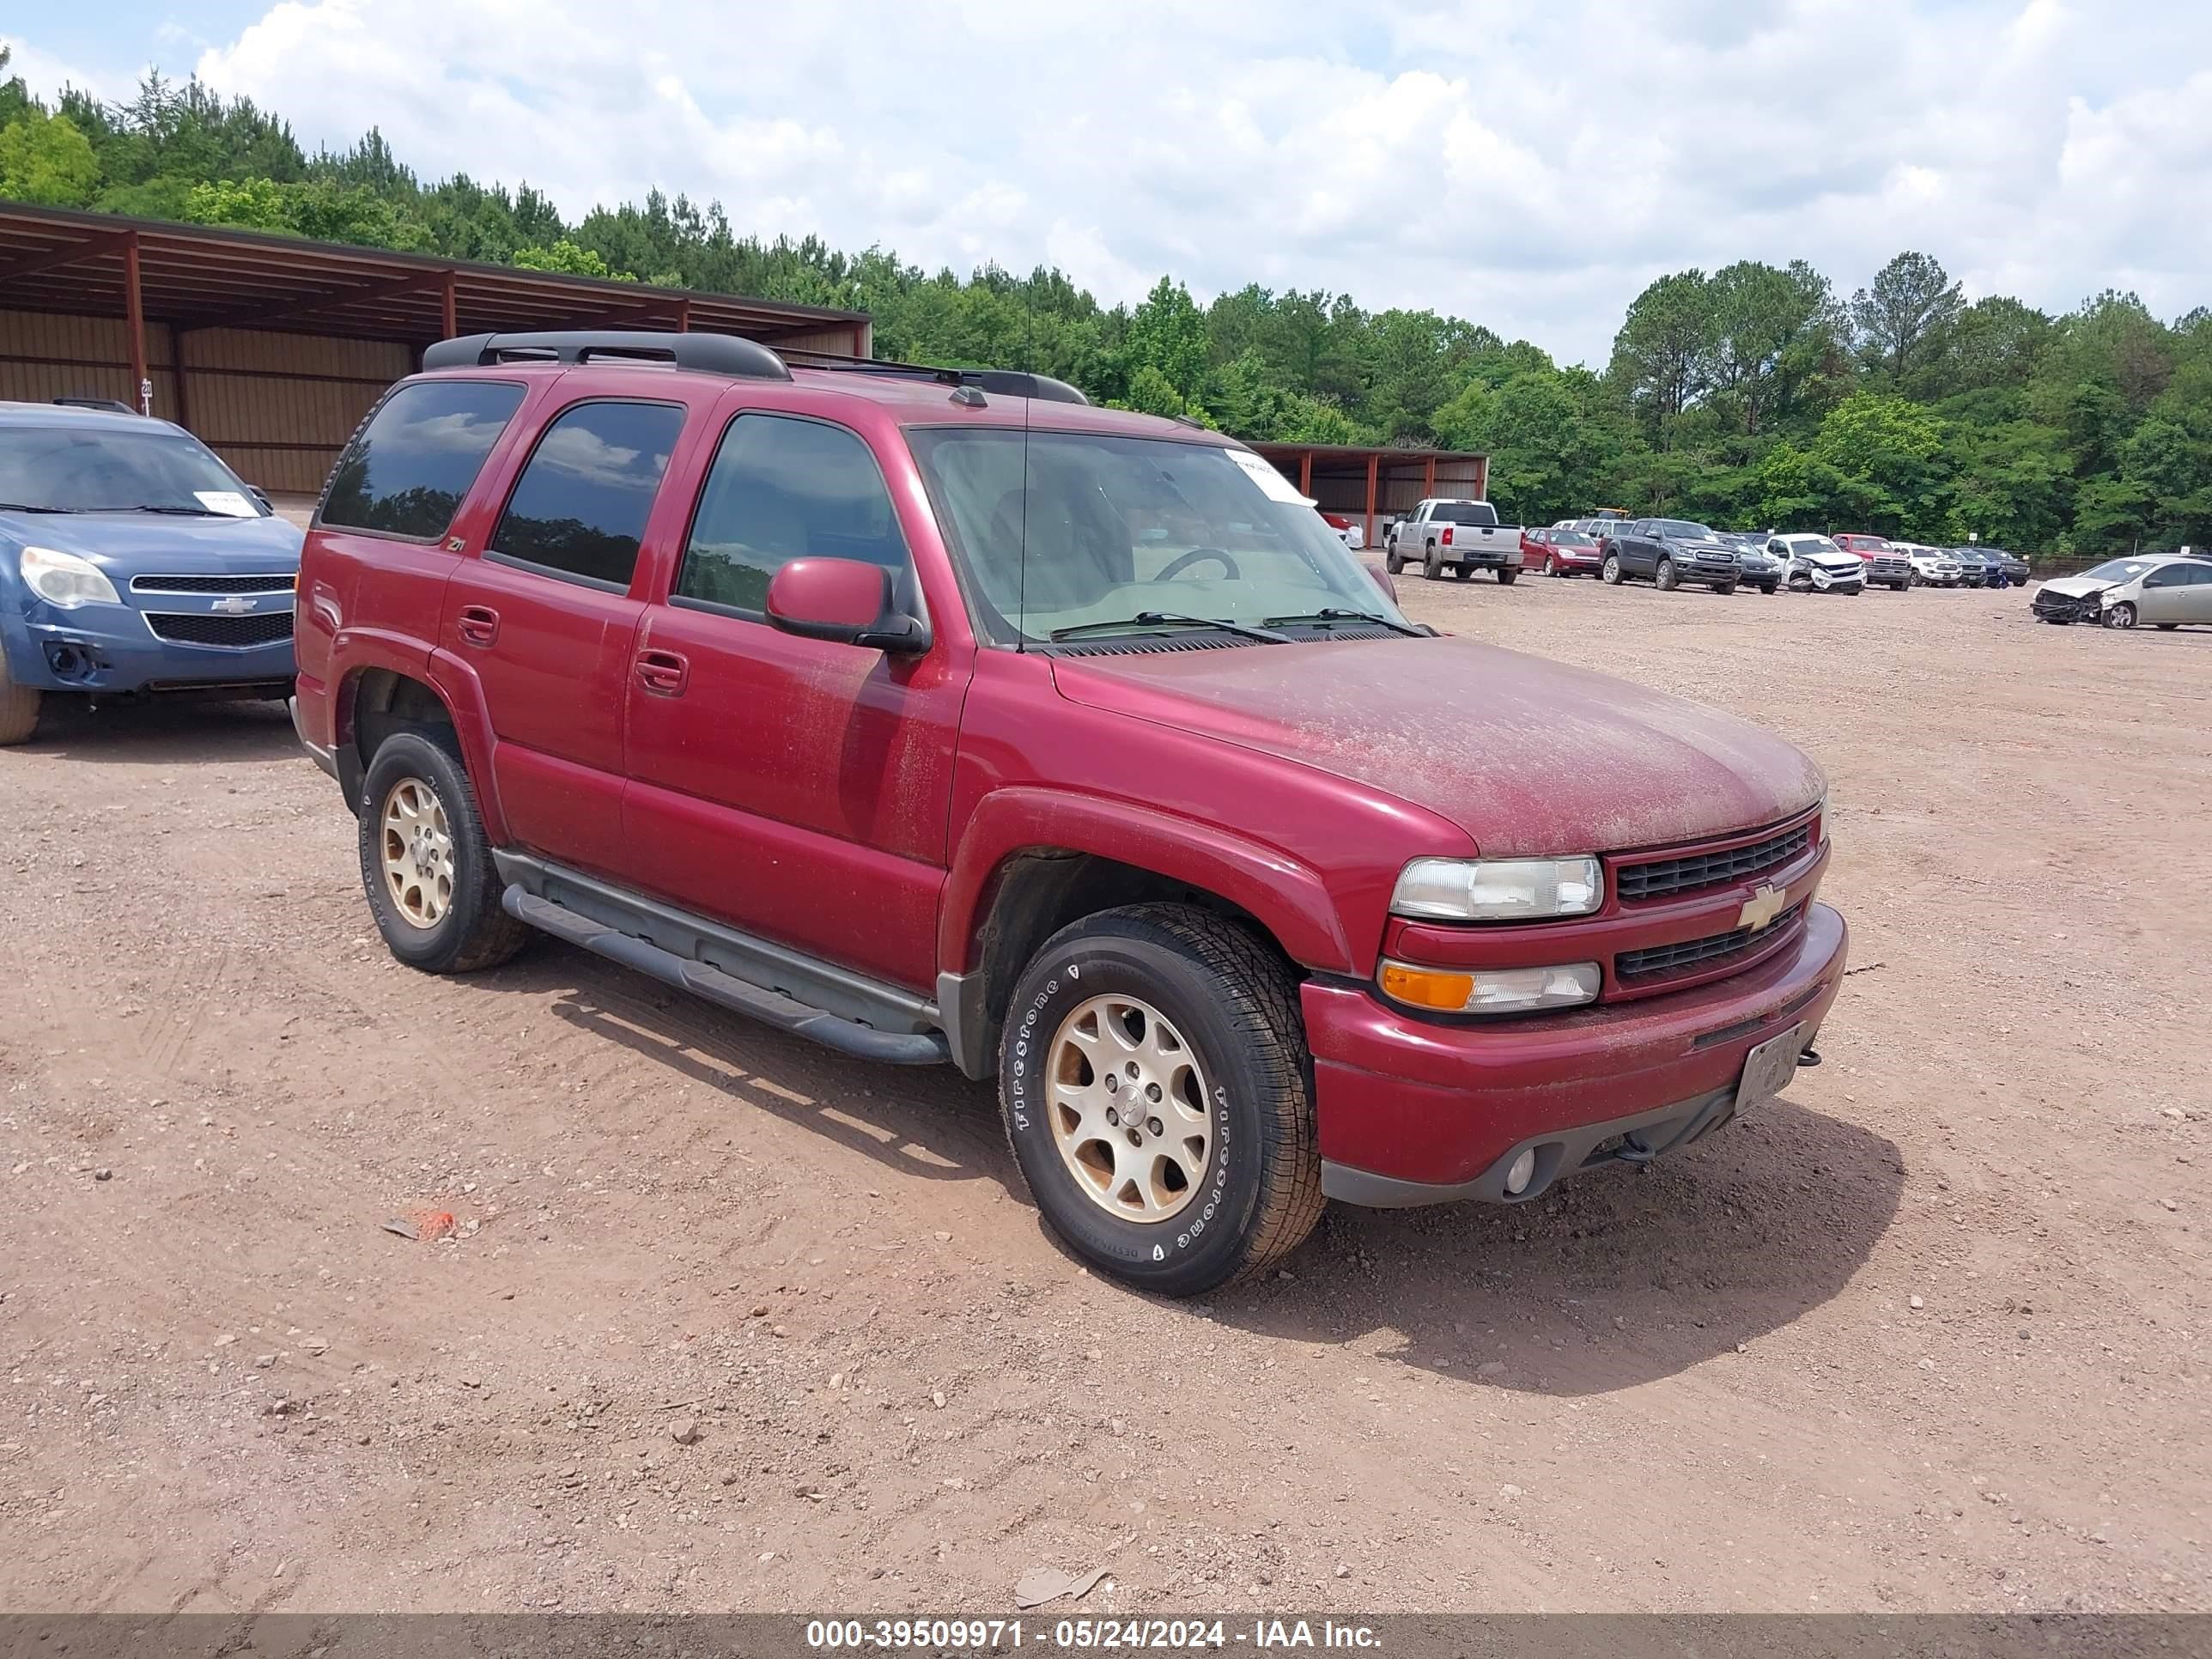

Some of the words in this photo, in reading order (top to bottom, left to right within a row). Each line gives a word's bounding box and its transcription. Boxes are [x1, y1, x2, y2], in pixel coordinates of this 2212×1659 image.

[143, 384, 151, 394] 20
[1013, 979, 1060, 1131] Firestone
[1177, 1085, 1231, 1249] Firestone
